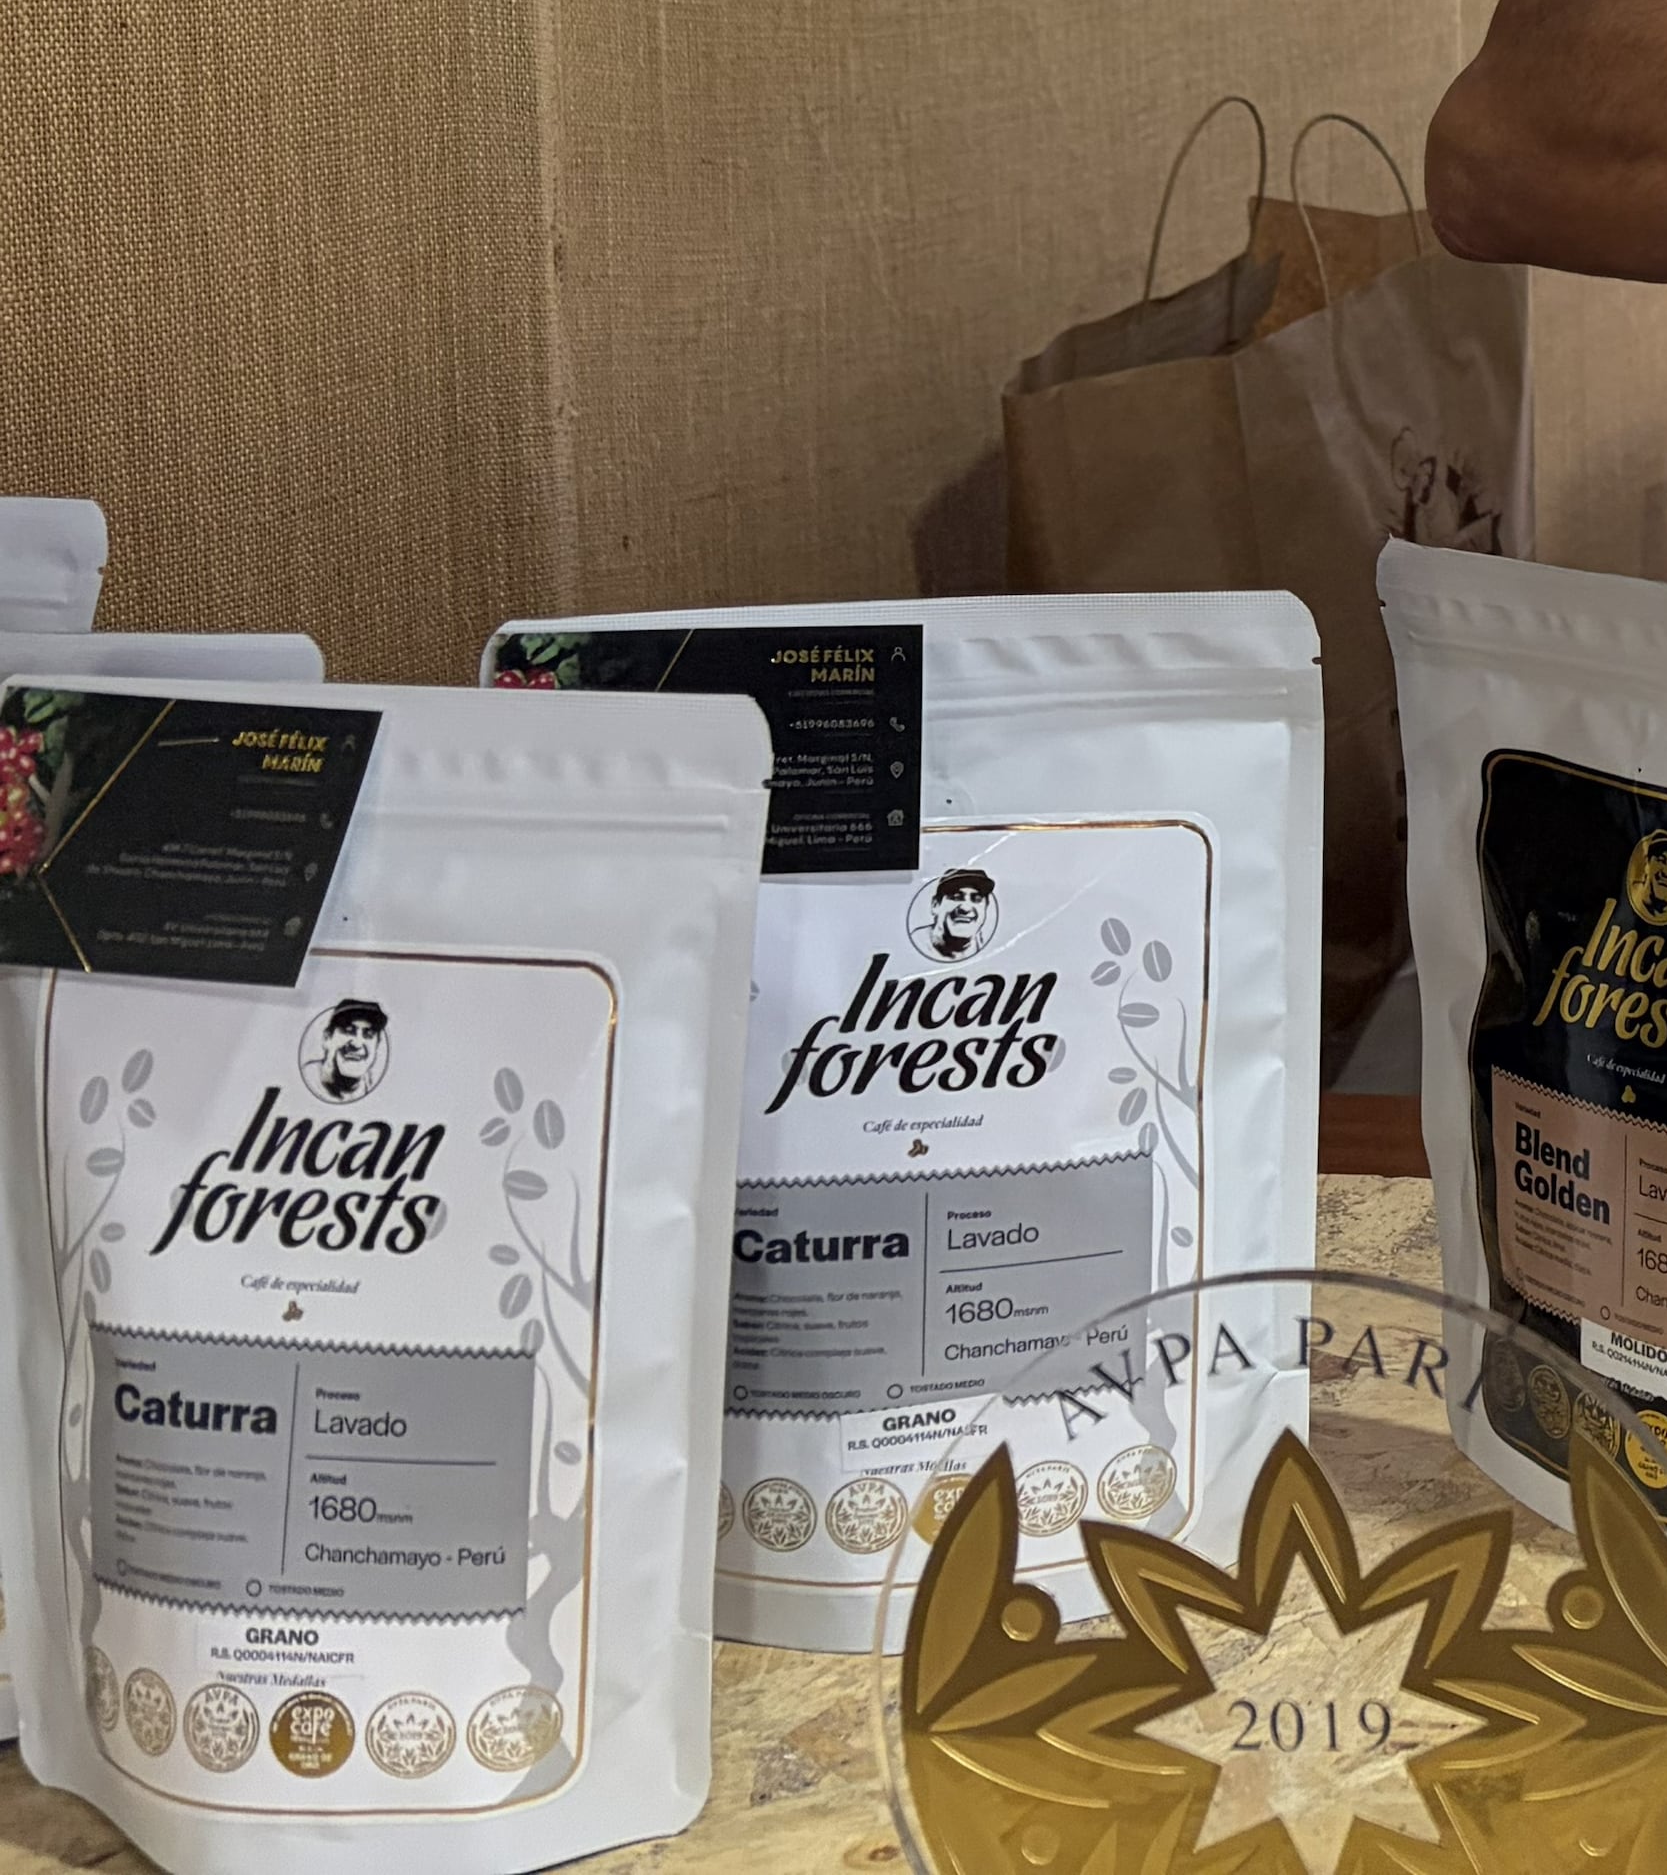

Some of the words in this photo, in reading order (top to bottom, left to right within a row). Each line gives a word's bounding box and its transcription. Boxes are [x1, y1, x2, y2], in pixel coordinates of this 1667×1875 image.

[770, 645, 820, 664] JOSÉ
[823, 645, 875, 663] FÉLIX
[811, 664, 875, 684] MARÍN
[232, 729, 277, 749] JOSÉ
[279, 730, 329, 752] FÉLIX
[262, 753, 325, 773] MARÍN
[838, 952, 1058, 1034] Incan
[764, 1015, 1058, 1115] forests
[227, 1086, 447, 1182] Incan
[863, 1119, 892, 1135] Café
[894, 1119, 908, 1131] de
[910, 1114, 984, 1134] especialidad
[1515, 1121, 1590, 1181] Blend
[149, 1151, 442, 1256] forests
[1514, 1160, 1610, 1225] Golden
[947, 1209, 992, 1221] Proceso
[733, 1229, 910, 1264] Caturra
[947, 1222, 1040, 1250] Lavado
[240, 1275, 270, 1292] Café
[270, 1277, 285, 1290] de
[286, 1278, 360, 1295] especialidad
[945, 1282, 983, 1294] Altitud
[1086, 1325, 1129, 1347] Perú
[910, 1381, 953, 1394] TOSTADO
[954, 1378, 985, 1389] MEDIO
[1055, 1321, 1258, 1442] AVPA
[1297, 1315, 1491, 1415] PARI
[315, 1388, 360, 1402] Proceso
[114, 1383, 278, 1436] Caturra
[882, 1408, 957, 1432] GRANO
[314, 1409, 408, 1438] Lavado
[304, 1542, 442, 1571] Chanchamayo
[457, 1545, 506, 1567] Perú
[245, 1627, 319, 1646] GRANO
[1226, 1699, 1393, 1753] 2019
